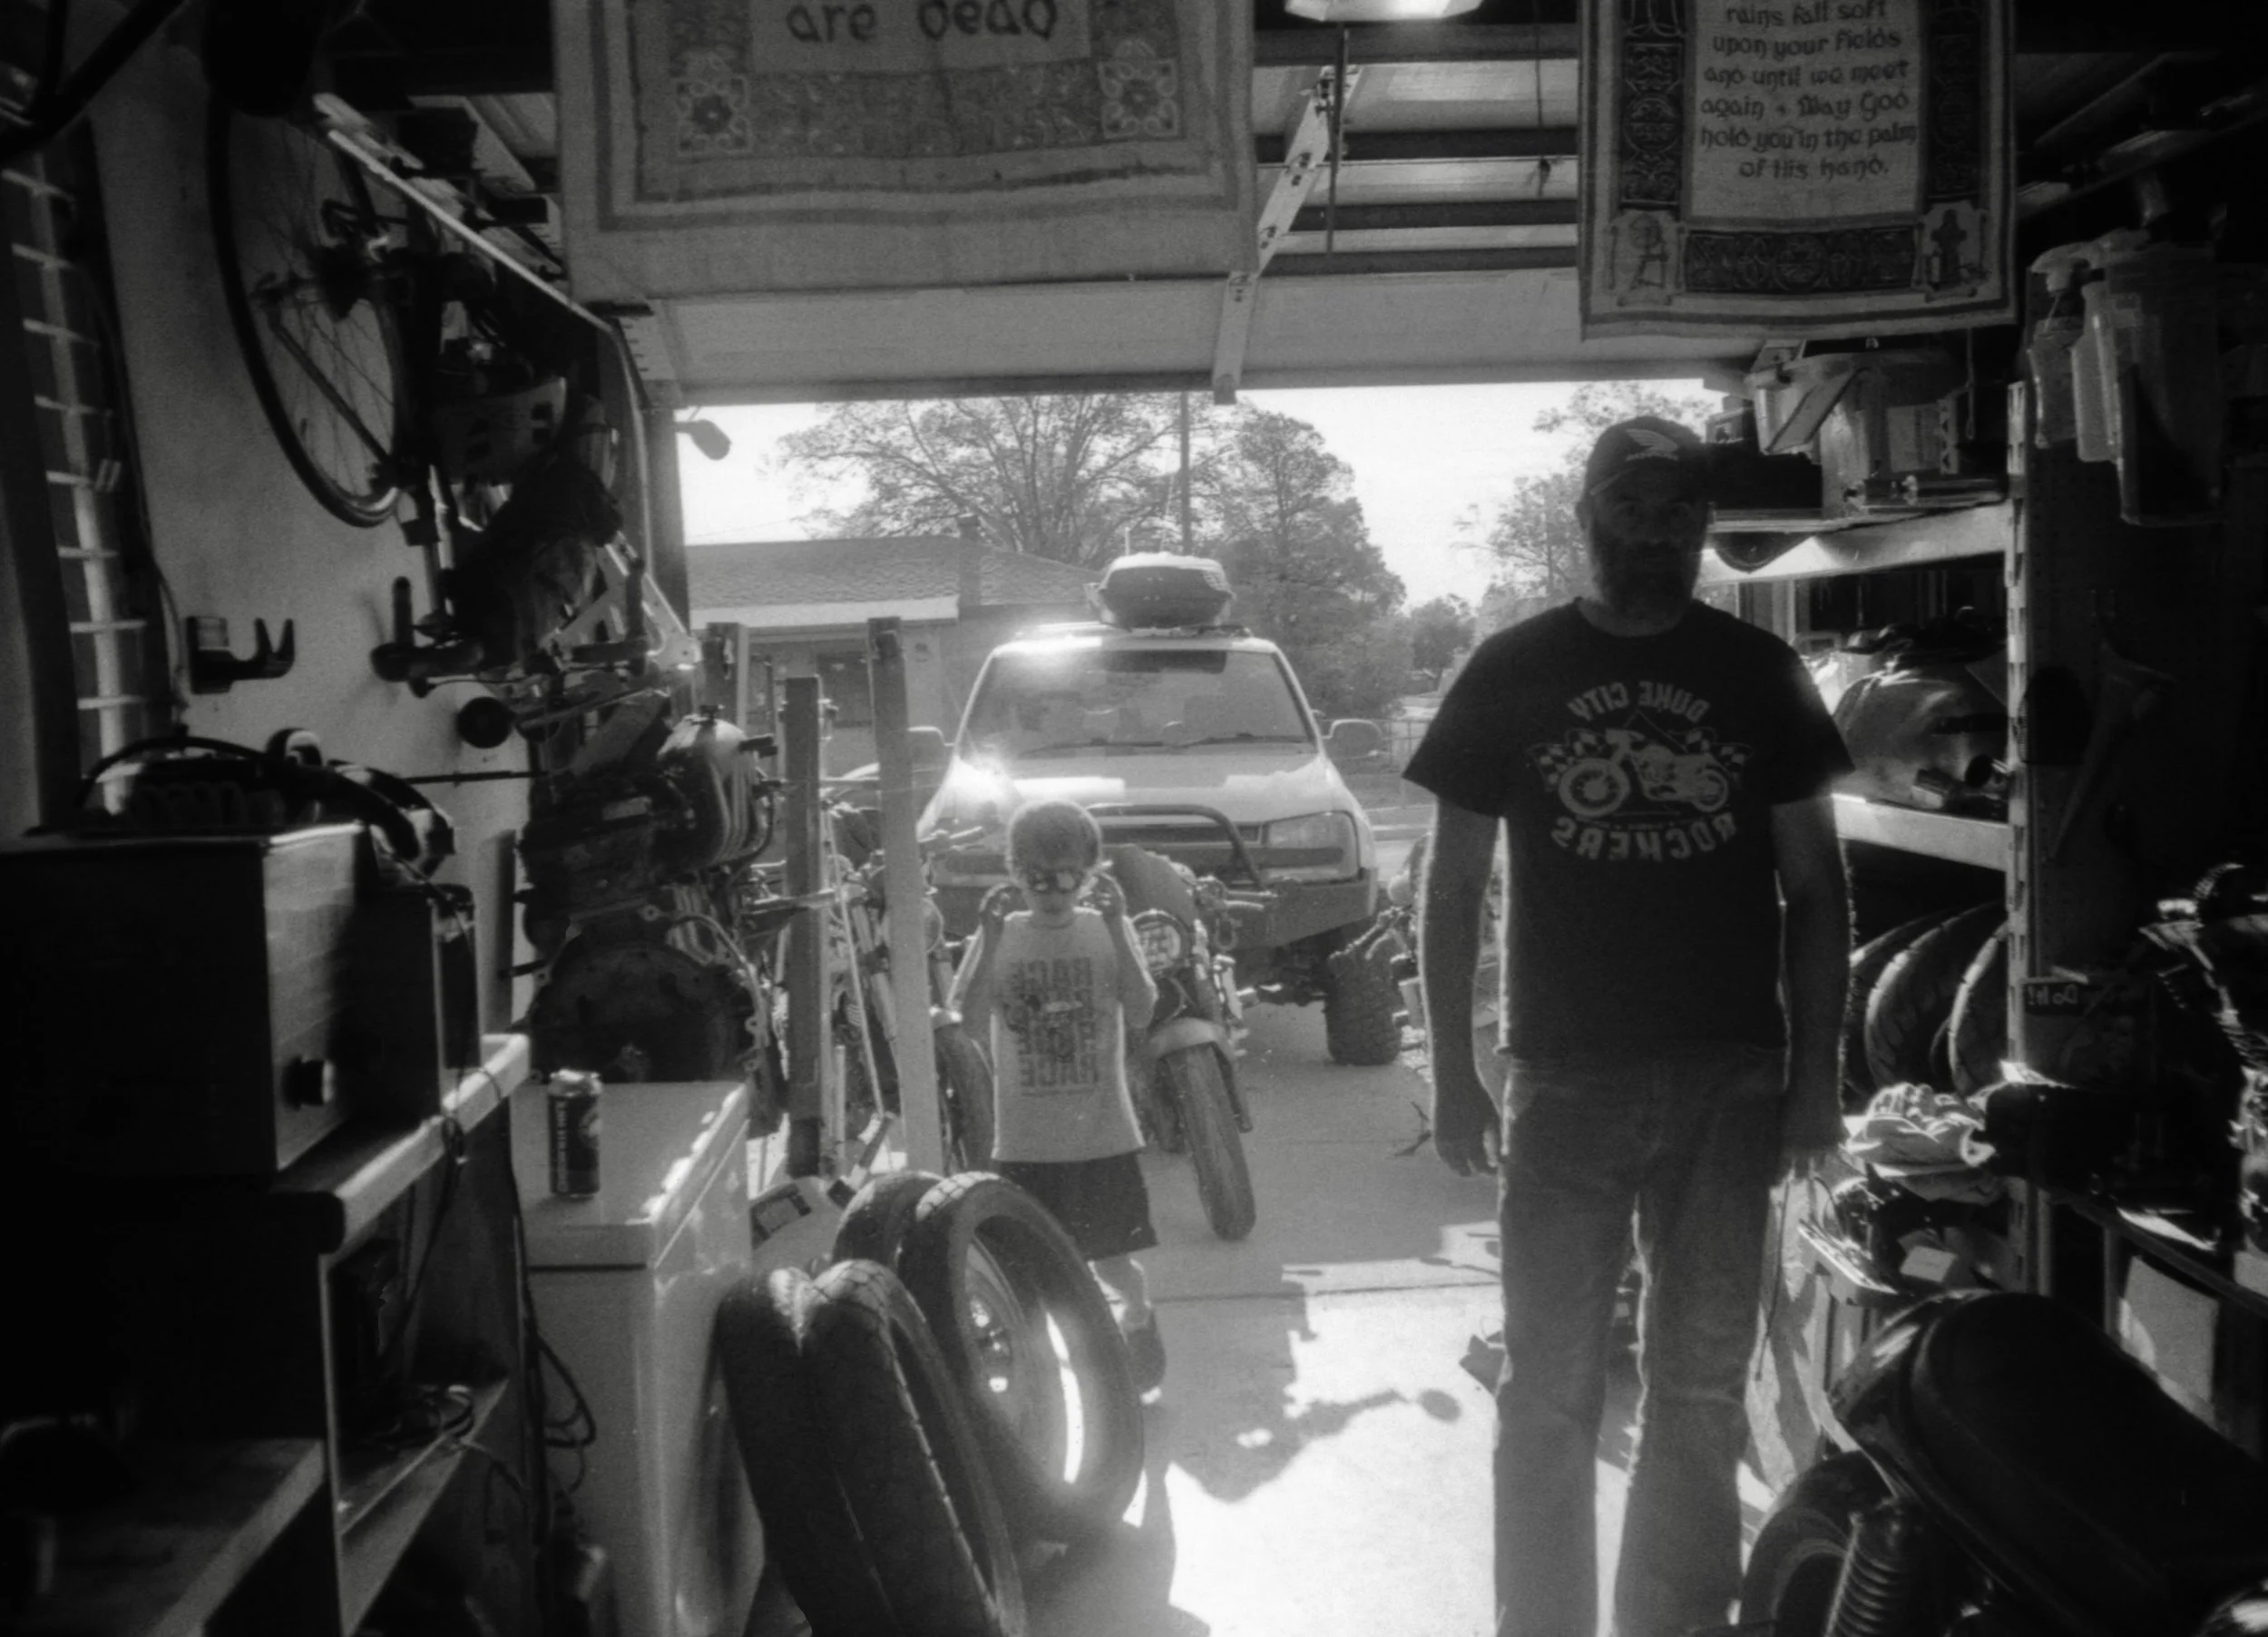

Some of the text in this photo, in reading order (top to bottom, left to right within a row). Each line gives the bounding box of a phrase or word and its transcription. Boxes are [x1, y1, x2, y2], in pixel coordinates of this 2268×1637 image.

[786, 4, 879, 43] are
[1726, 0, 1887, 28] rains fall soft
[1712, 27, 1901, 62] upon your fields
[1703, 60, 1911, 91] and until we meet
[1700, 90, 1910, 123] again May God
[1701, 122, 1919, 154] hold you in the palm
[1738, 158, 1767, 179] of
[1773, 159, 1809, 181] His
